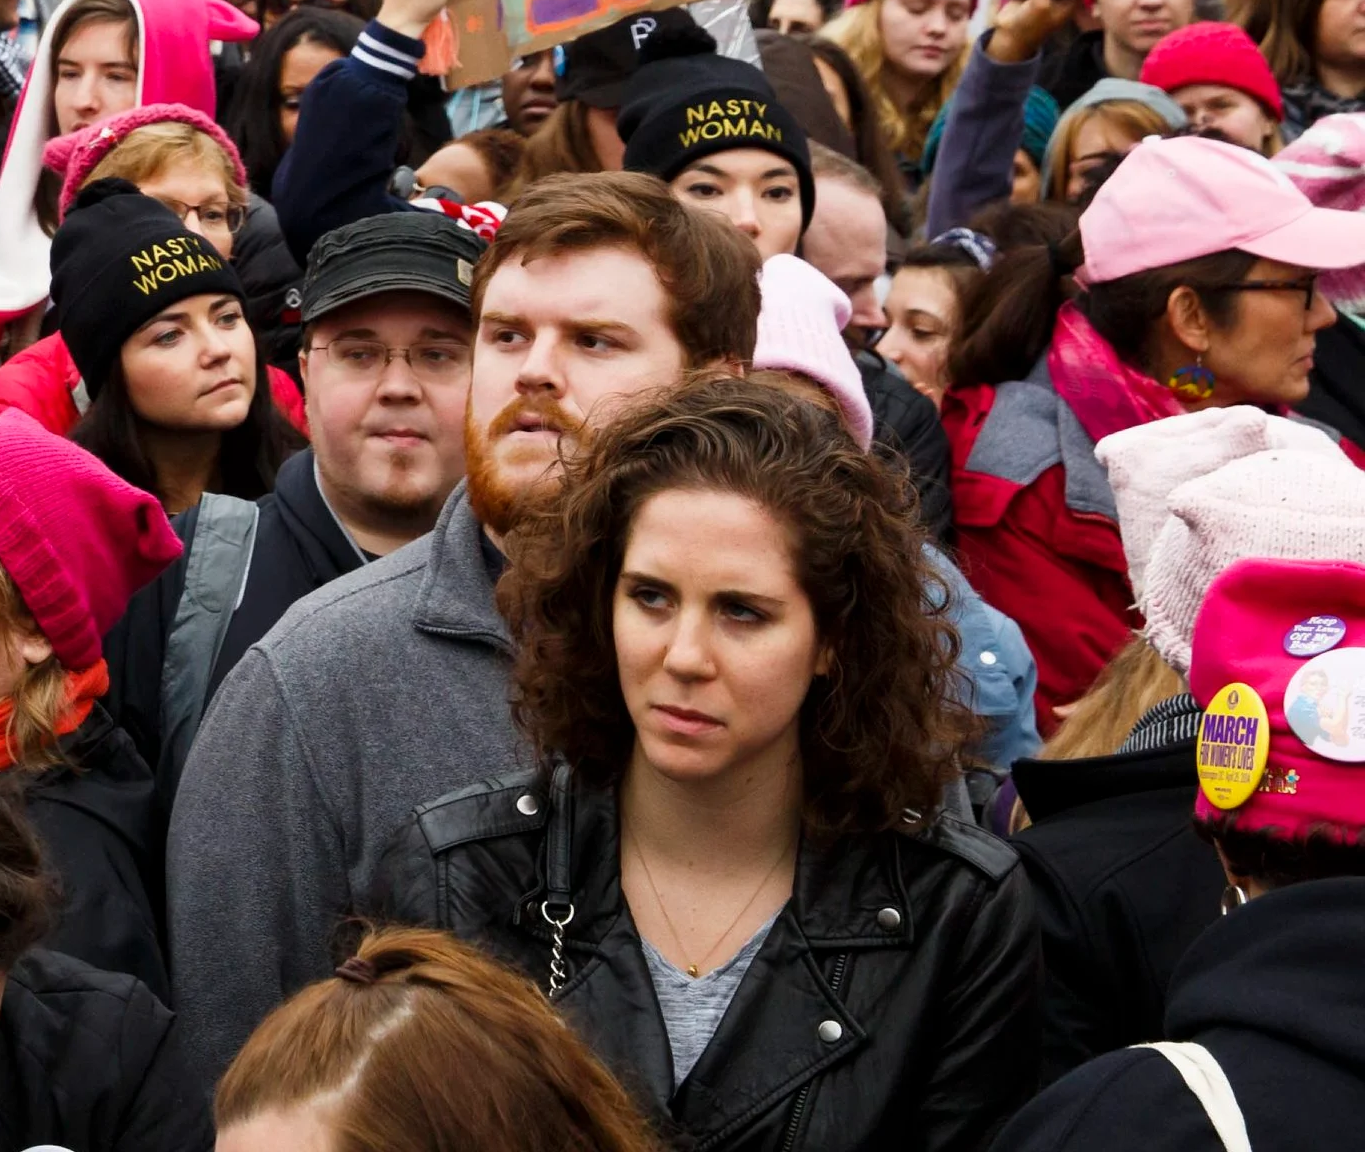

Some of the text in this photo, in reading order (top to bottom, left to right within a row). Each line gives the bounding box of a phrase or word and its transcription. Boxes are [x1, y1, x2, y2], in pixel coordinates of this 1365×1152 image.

[686, 99, 767, 125] NASTY
[678, 118, 782, 148] WOMAN
[131, 237, 202, 272] NASTY
[133, 254, 223, 295] WOMAN
[1202, 714, 1259, 746] MARCH
